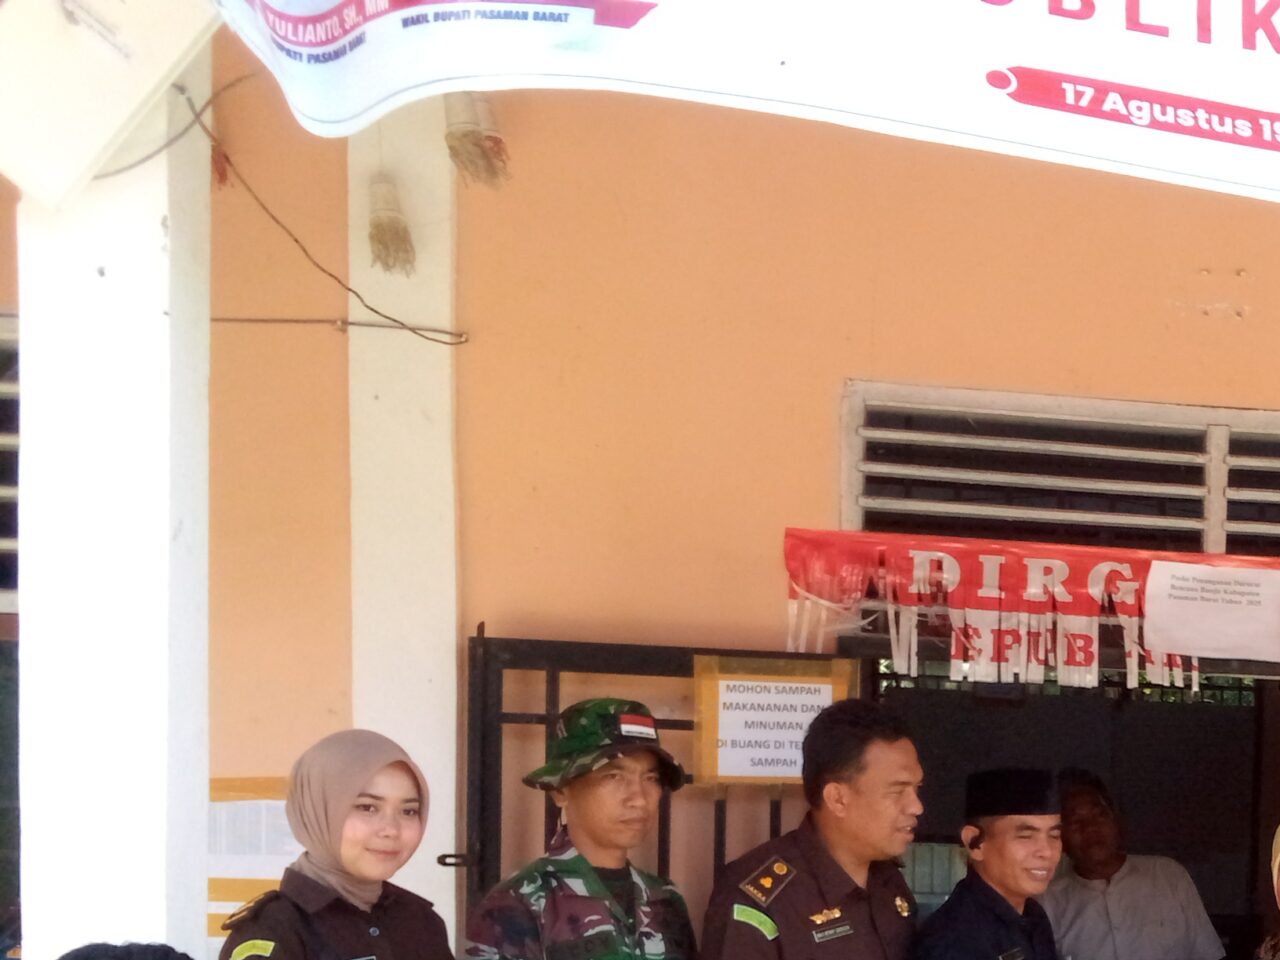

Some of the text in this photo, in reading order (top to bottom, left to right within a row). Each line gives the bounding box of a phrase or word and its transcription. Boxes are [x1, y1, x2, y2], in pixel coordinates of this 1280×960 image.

[433, 10, 471, 22] BUPATI
[474, 10, 528, 20] PASAMAN
[532, 11, 570, 22] BARAT
[1061, 82, 1095, 107] 17
[1101, 91, 1253, 138] Agustus
[726, 683, 822, 696] MOHON SAMPAH
[722, 701, 825, 714] MAKANANAN DAN
[744, 719, 803, 731] MINUMAN
[717, 738, 727, 749] DI
[731, 739, 771, 750] BUANG
[774, 740, 785, 750] DI
[750, 757, 797, 768] SAMPAH
